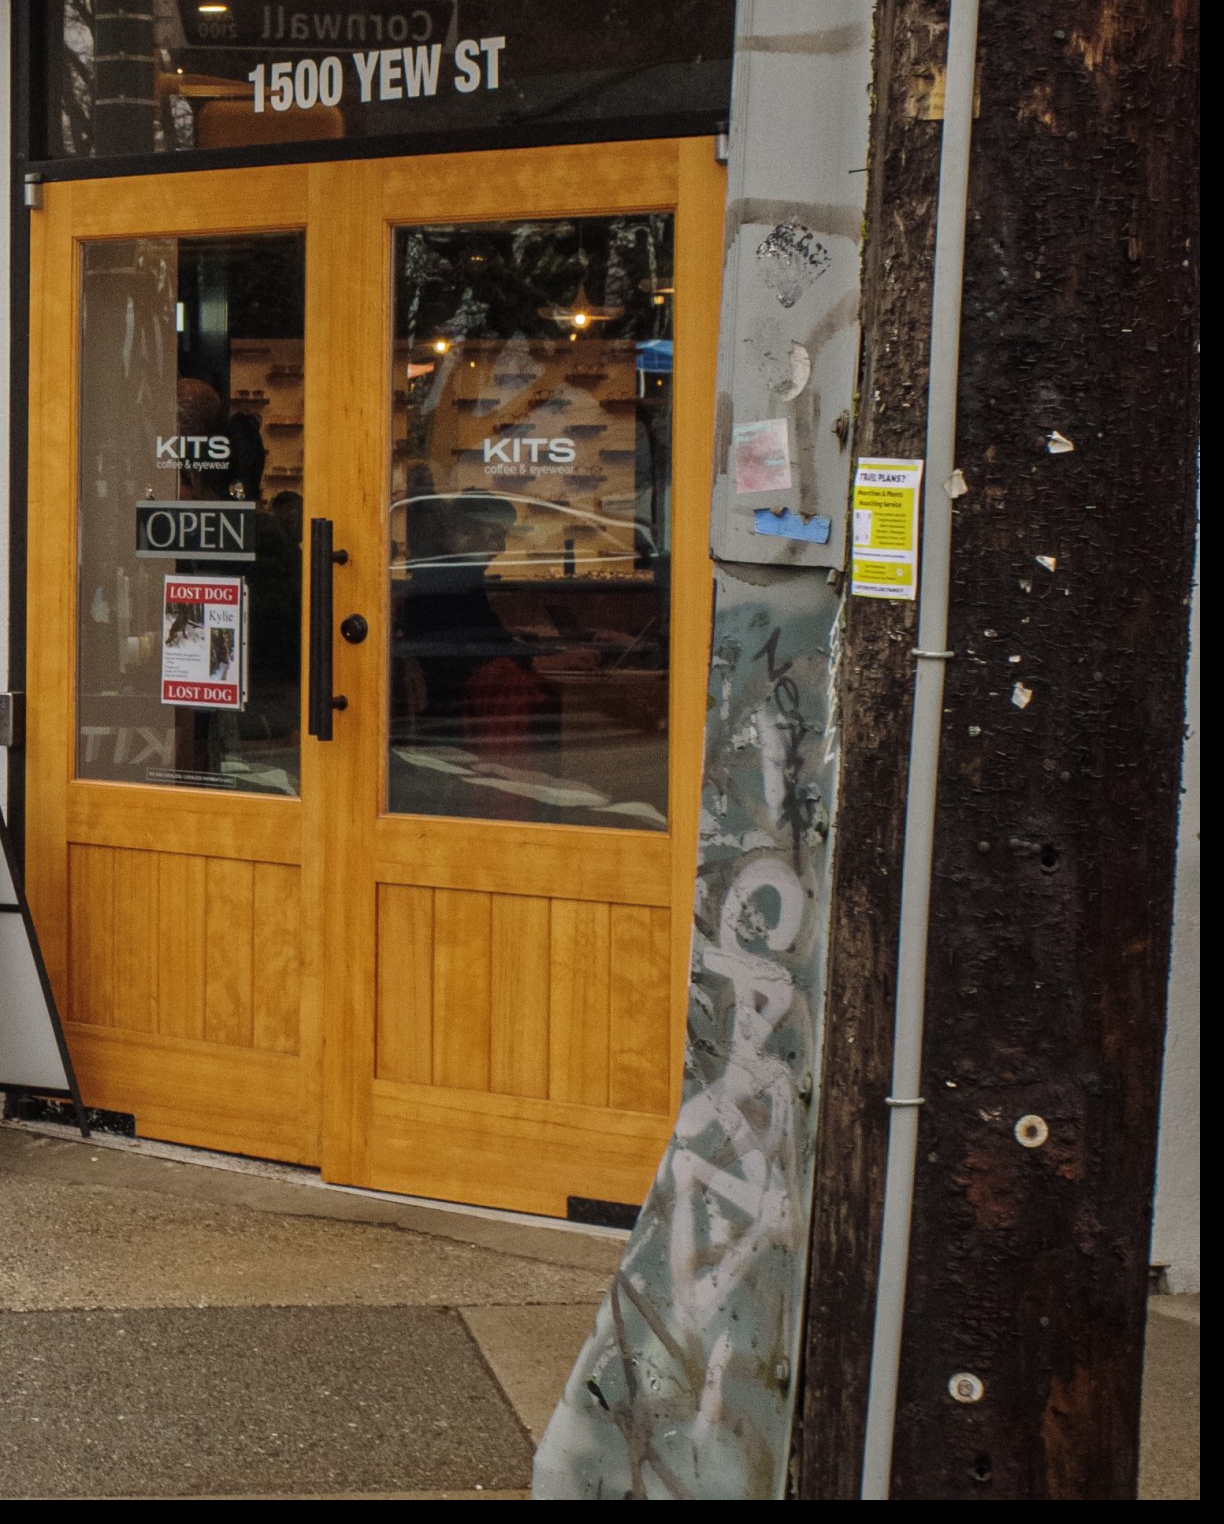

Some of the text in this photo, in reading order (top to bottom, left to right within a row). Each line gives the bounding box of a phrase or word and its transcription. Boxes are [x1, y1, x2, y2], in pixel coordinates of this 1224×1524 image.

[248, 36, 506, 113] 1500 YEW ST
[156, 436, 231, 459] KITS
[483, 438, 576, 463] KITS
[157, 459, 230, 471] coffee & eyewear
[484, 463, 575, 476] coffee & eyewear
[146, 511, 245, 550] OPEN
[170, 586, 233, 601] LOST DOG
[209, 610, 234, 624] Kylie
[168, 685, 232, 701] LOST DOG
